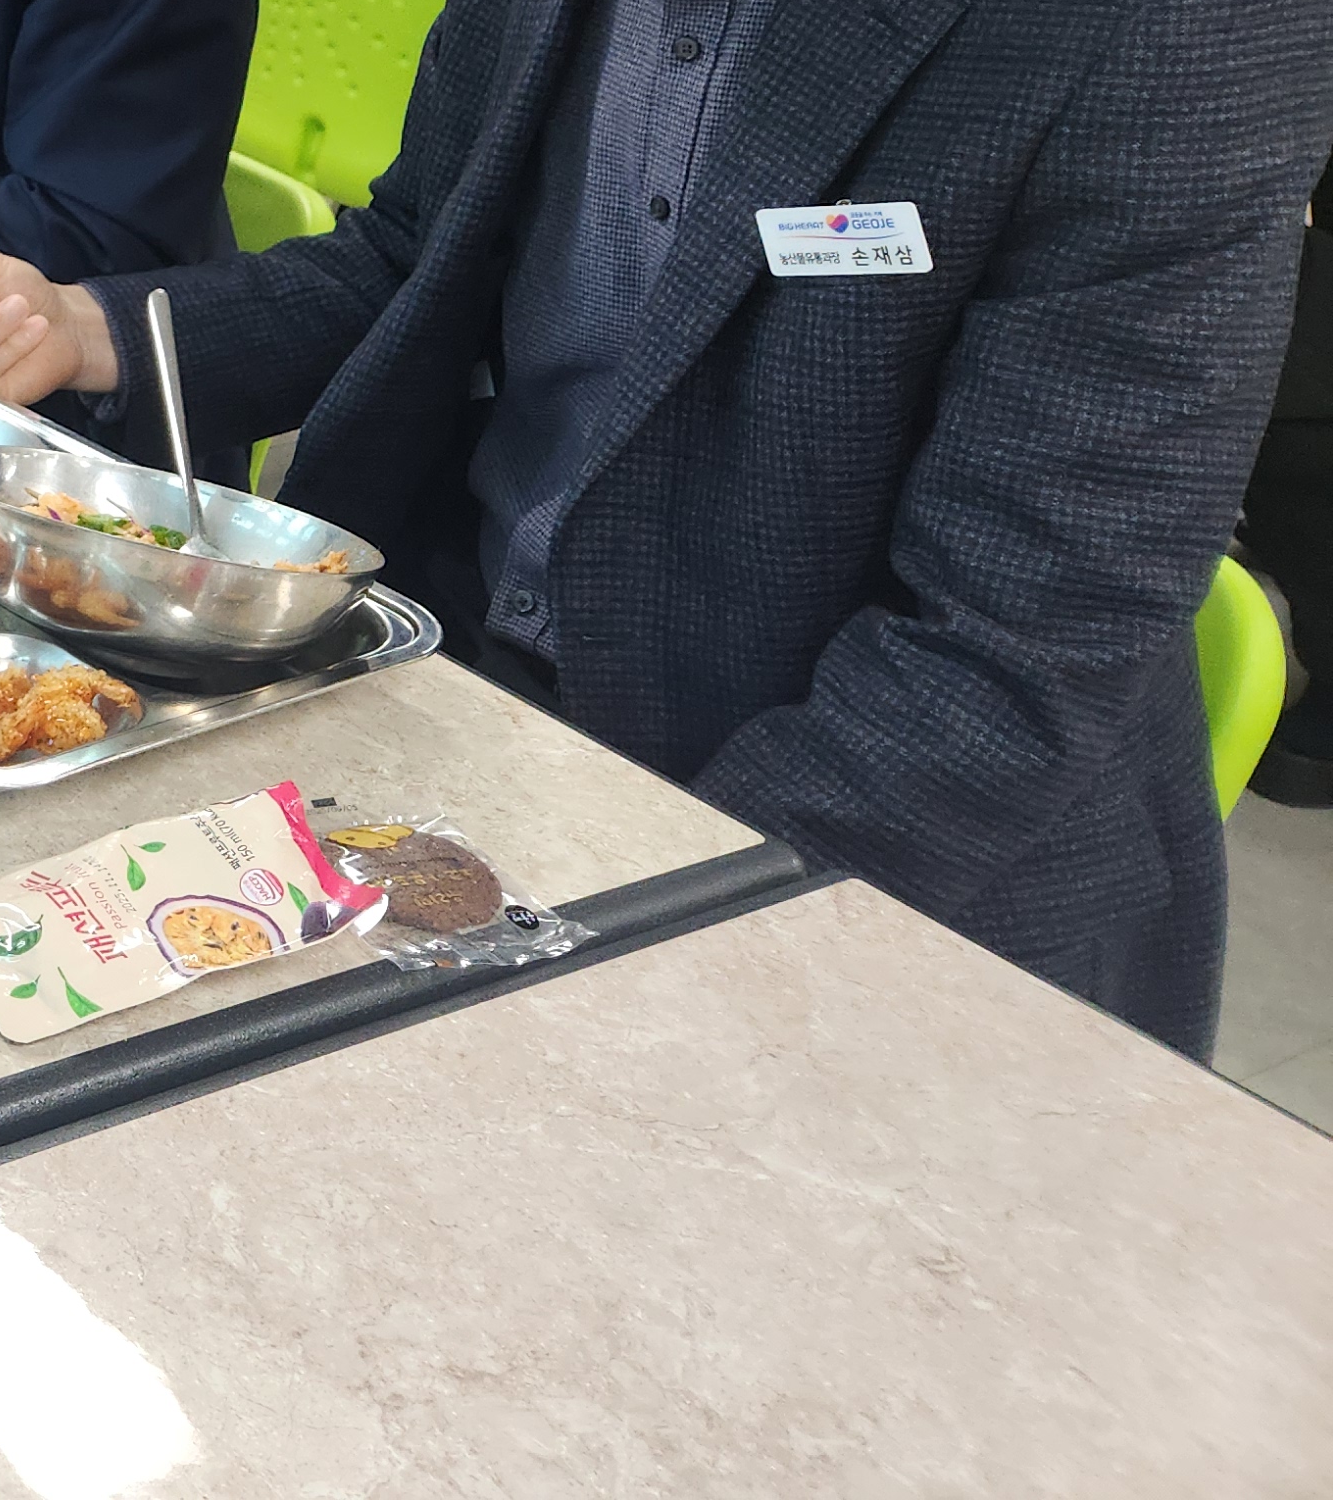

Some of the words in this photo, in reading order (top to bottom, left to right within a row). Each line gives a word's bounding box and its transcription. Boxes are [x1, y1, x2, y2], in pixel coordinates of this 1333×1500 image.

[852, 217, 896, 231] GEOJE
[851, 244, 914, 267] 손재삼
[237, 844, 256, 862] 150
[248, 875, 272, 901] HACCP
[88, 881, 129, 930] Passion
